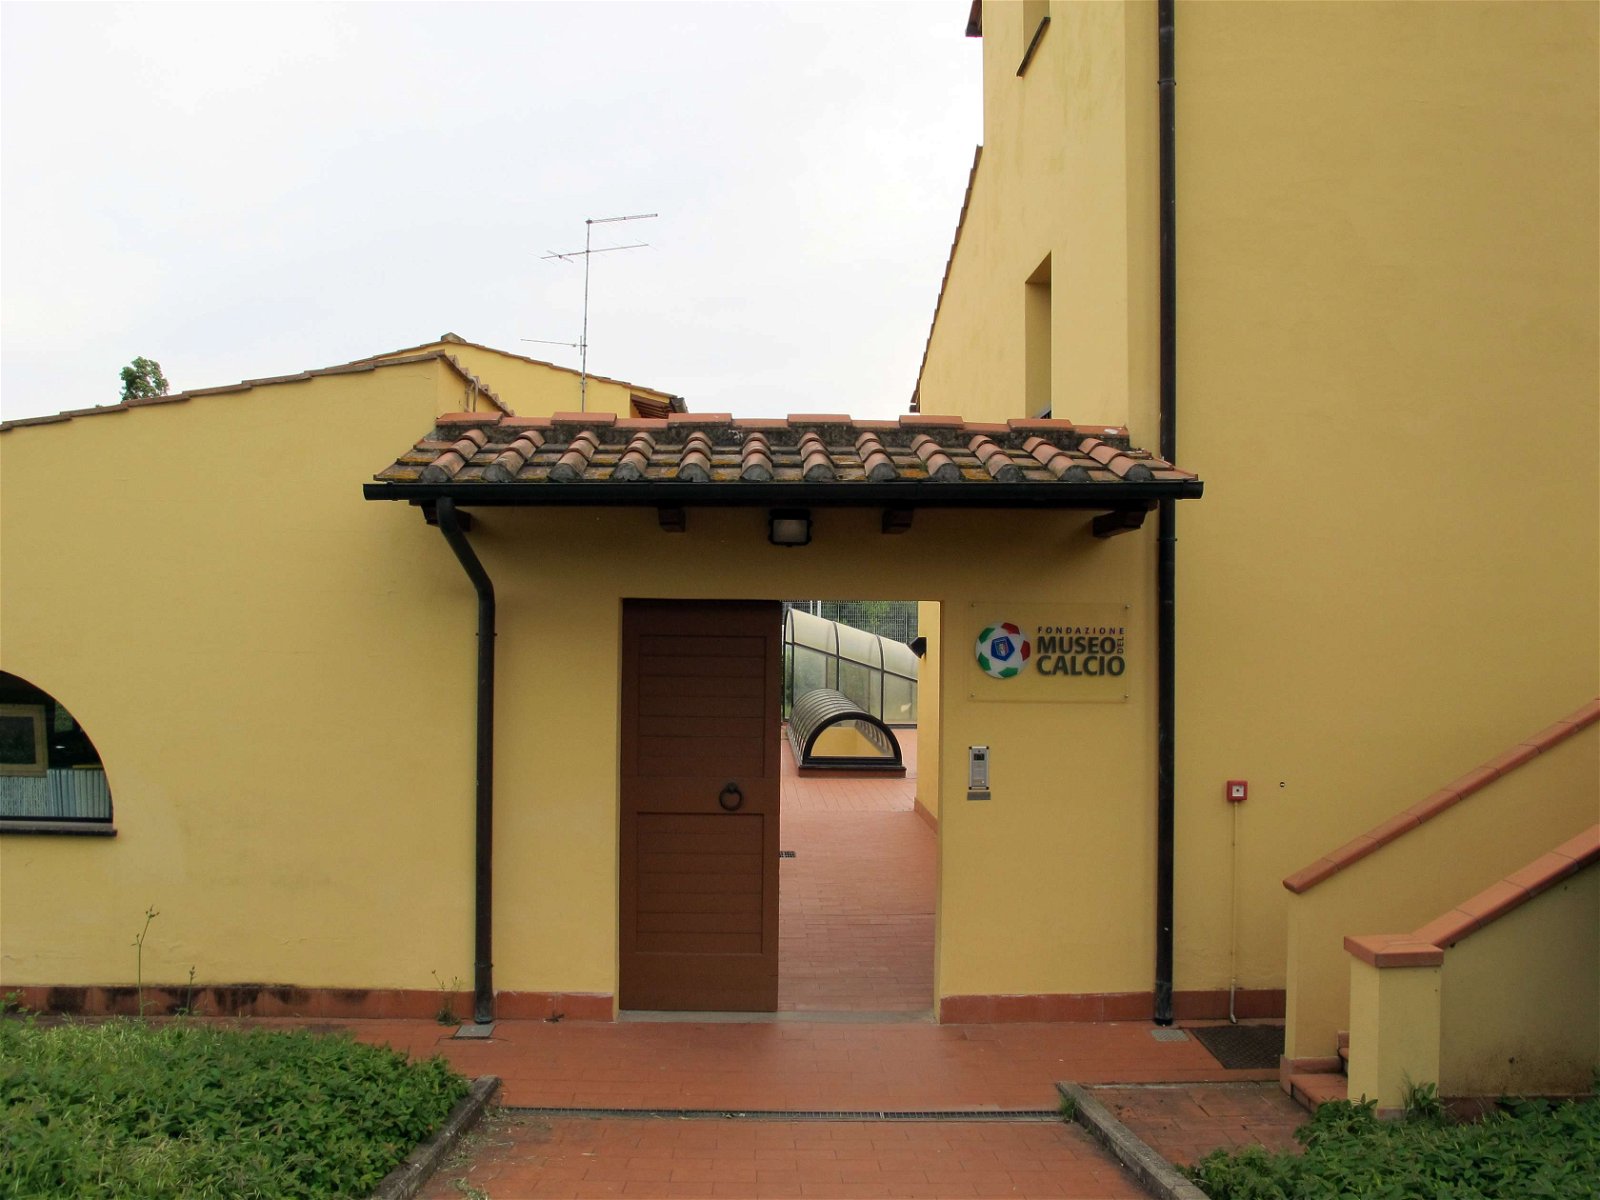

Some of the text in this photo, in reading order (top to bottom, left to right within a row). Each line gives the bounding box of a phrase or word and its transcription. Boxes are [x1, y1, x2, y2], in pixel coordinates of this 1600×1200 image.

[1037, 626, 1124, 634] FONDAZIONE
[1037, 636, 1116, 654] MUSEO
[1037, 655, 1125, 676] CALCIO
